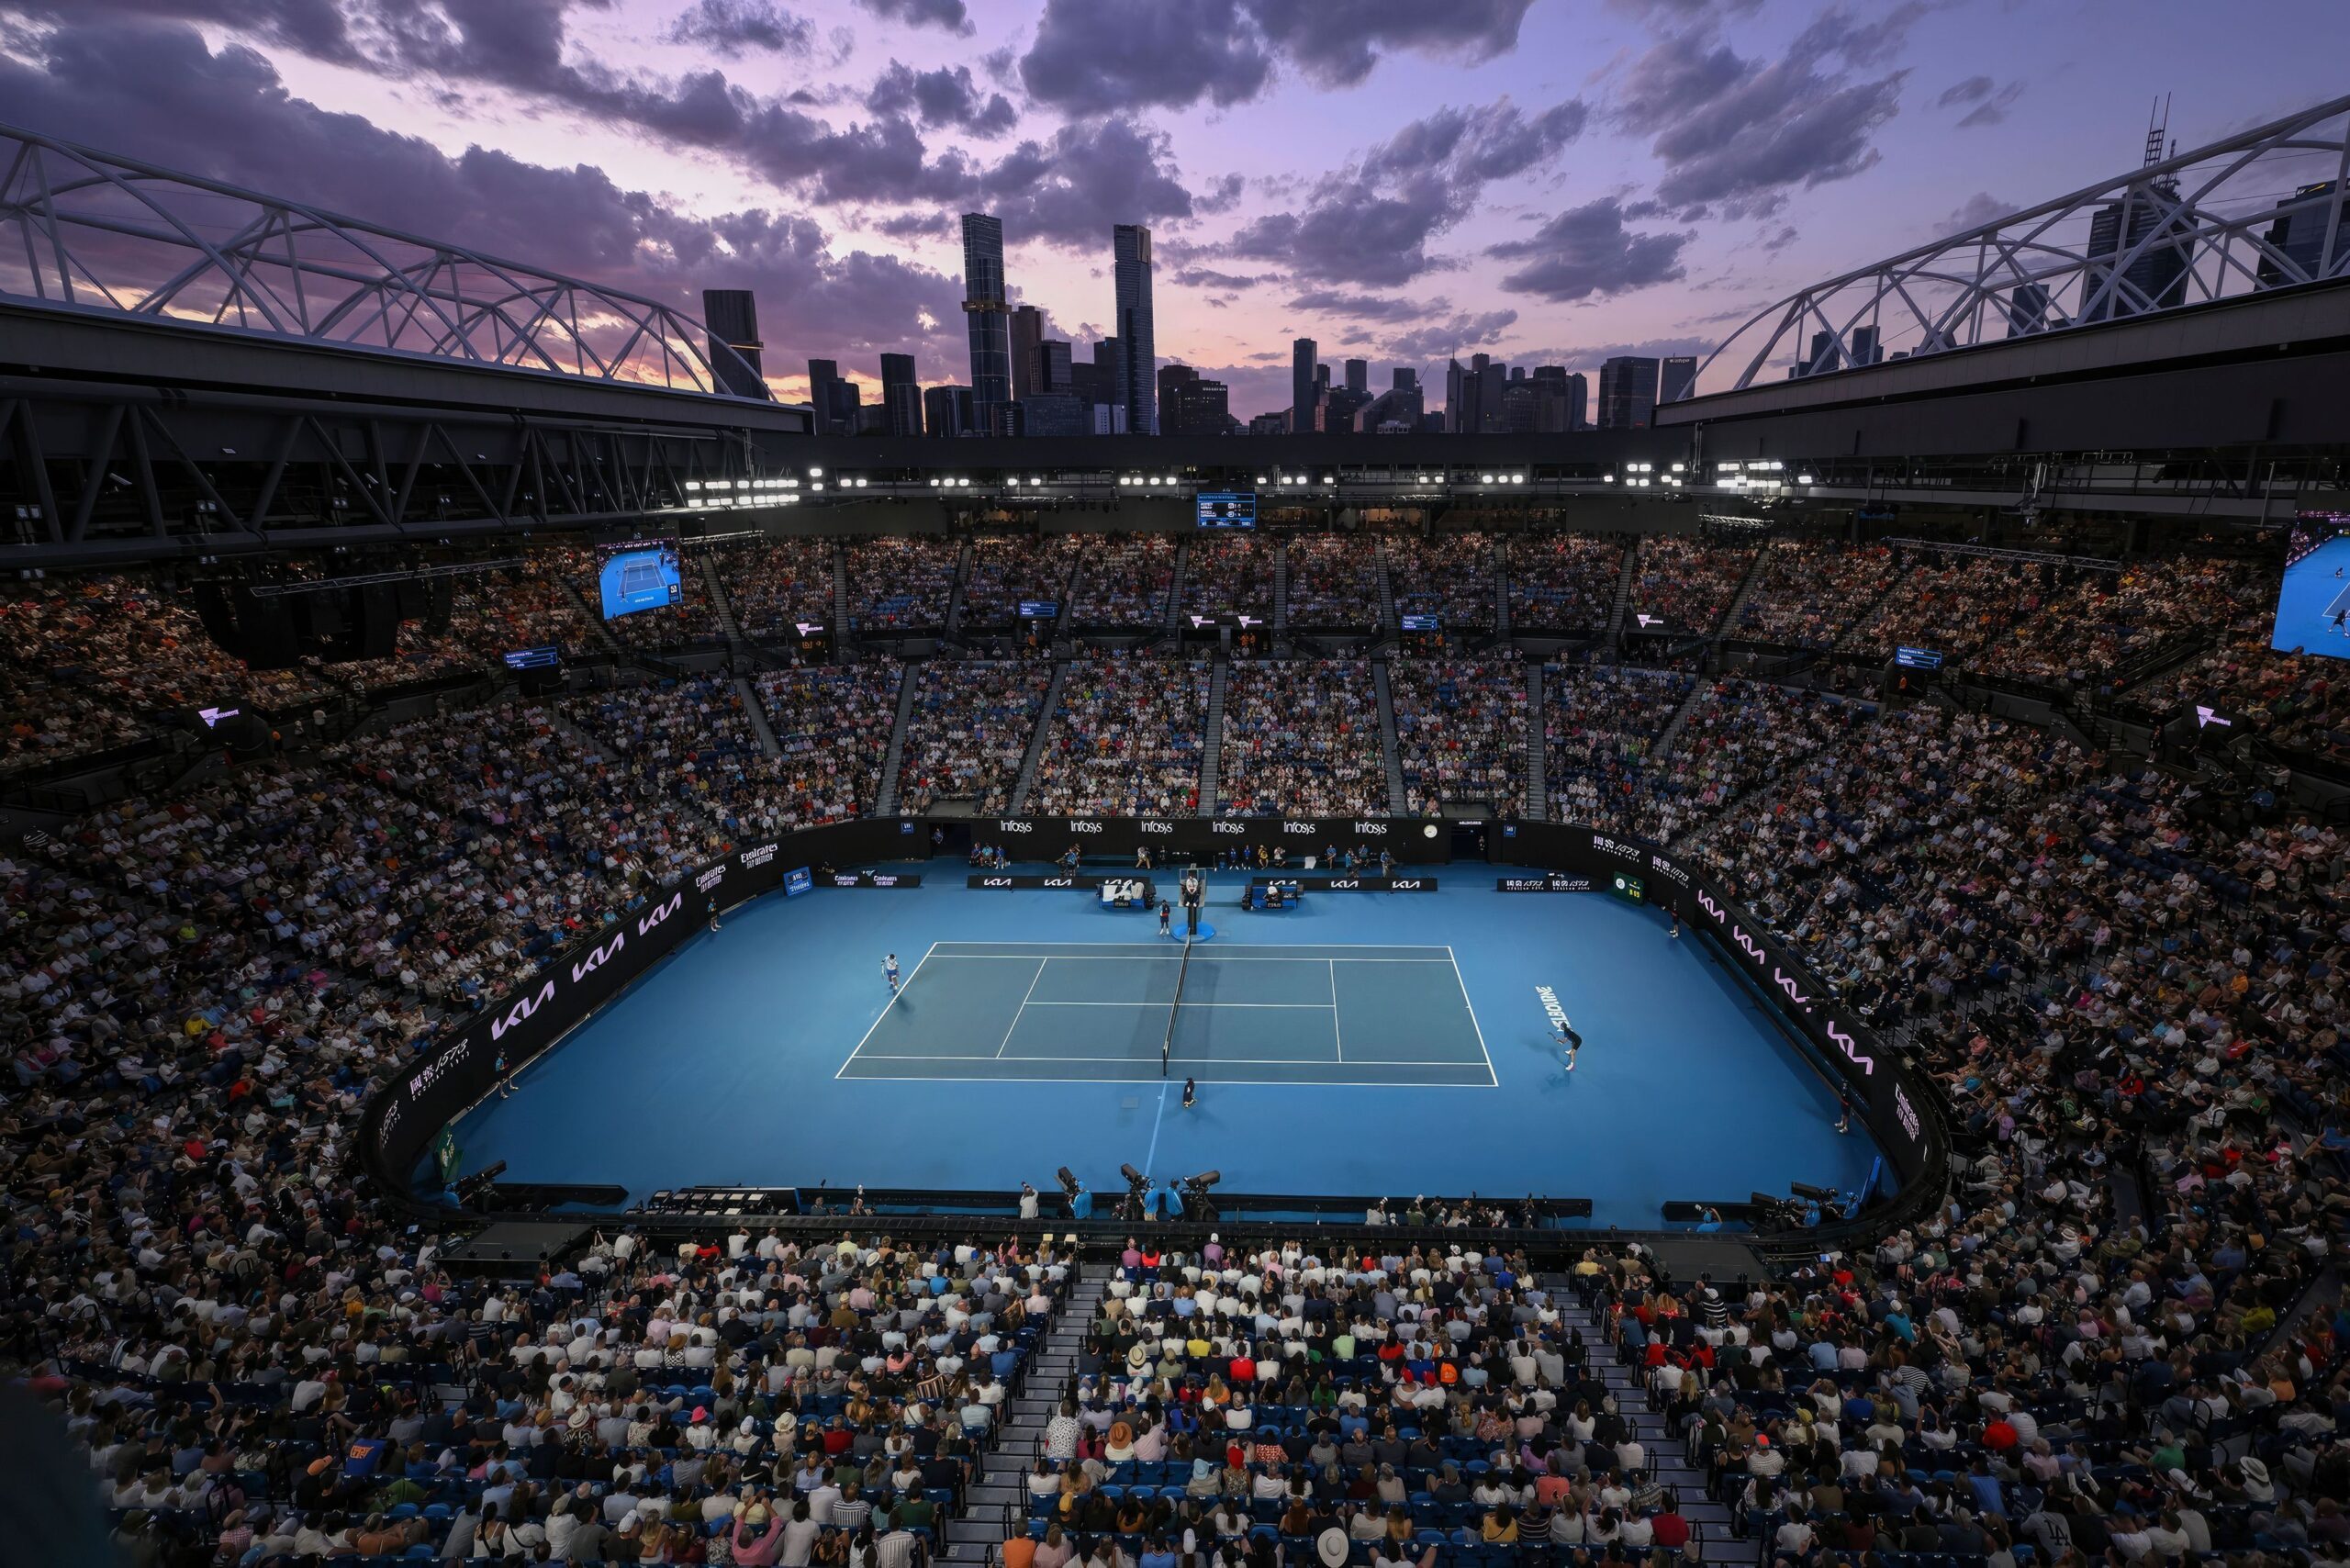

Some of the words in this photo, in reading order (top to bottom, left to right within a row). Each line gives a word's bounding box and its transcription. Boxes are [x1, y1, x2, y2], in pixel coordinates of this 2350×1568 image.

[1001, 821, 1033, 834] Infosys
[1070, 821, 1102, 834] Infosys
[1141, 821, 1173, 834] Infosys
[1213, 821, 1245, 834] Infosys
[1283, 822, 1315, 834] Infosys
[1355, 822, 1387, 834] Infosys
[741, 843, 778, 864] Emirates
[638, 892, 682, 936] KIA
[1697, 889, 1725, 924] KIA
[1733, 924, 1765, 965] KIA
[572, 932, 625, 983] KIA
[491, 980, 555, 1041] KIA
[1827, 1020, 1874, 1075] KIA
